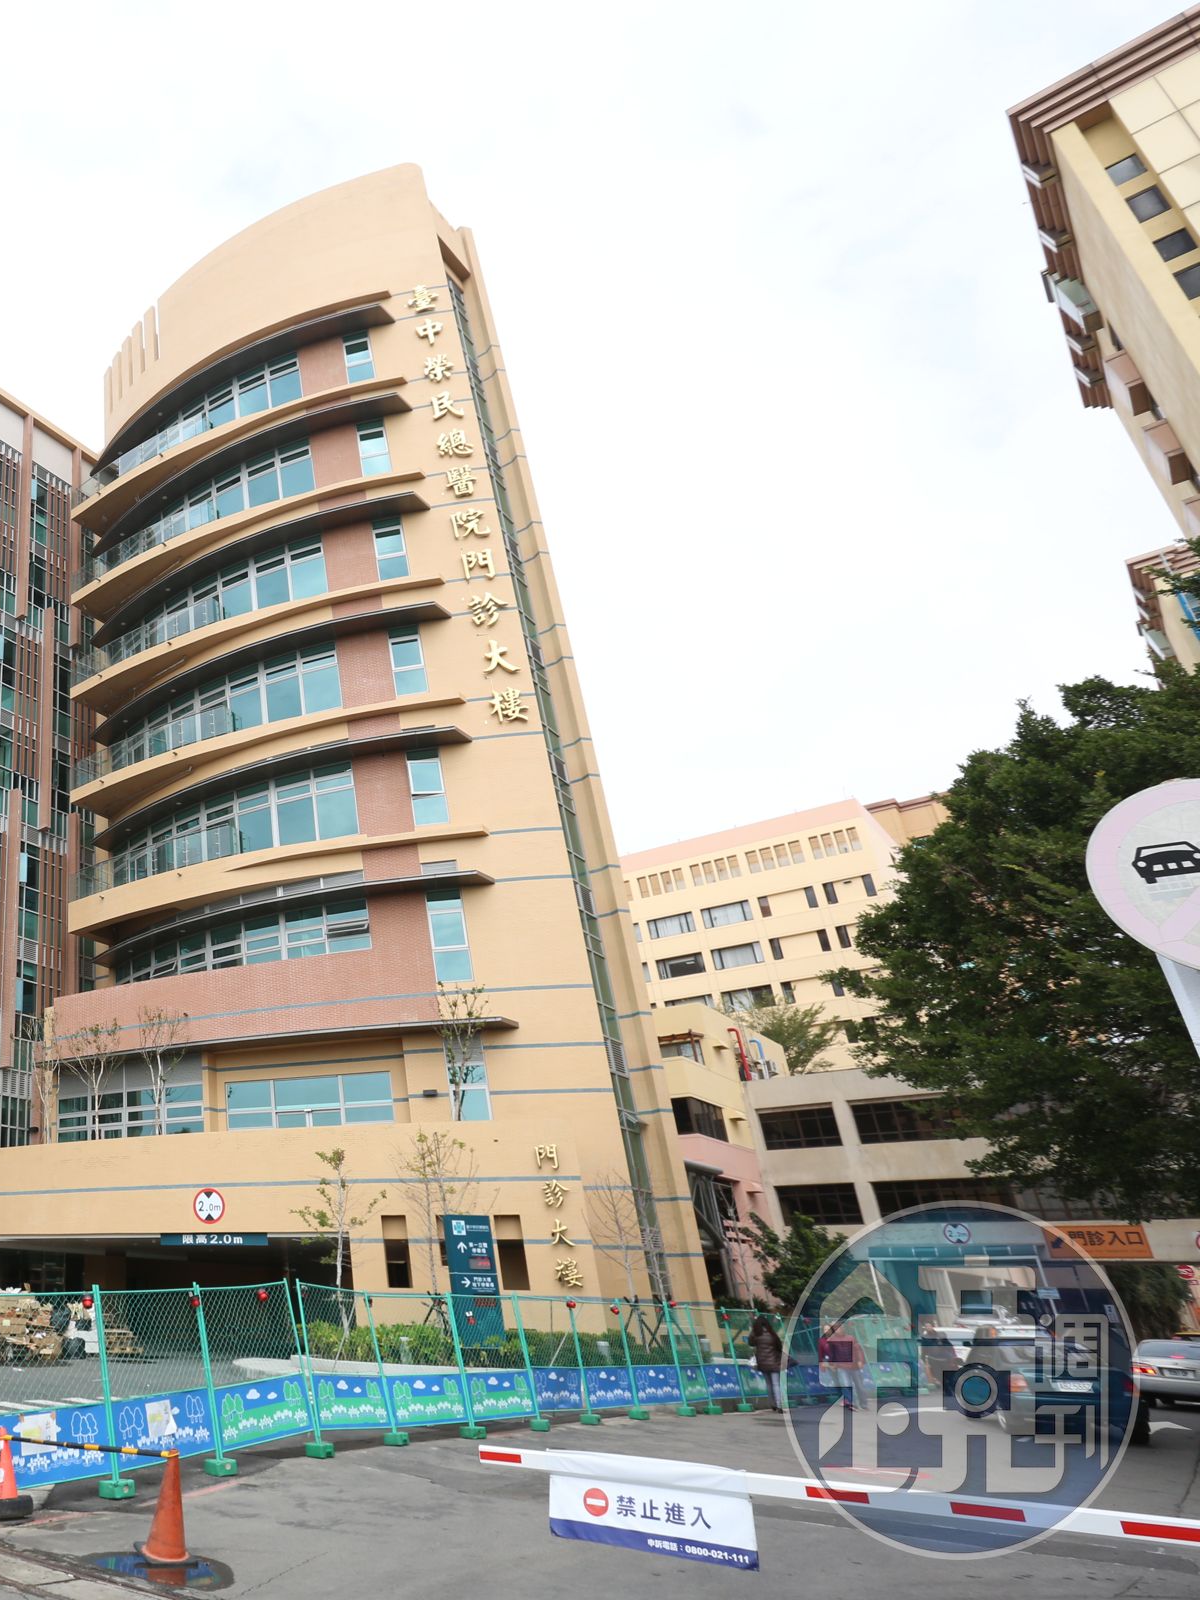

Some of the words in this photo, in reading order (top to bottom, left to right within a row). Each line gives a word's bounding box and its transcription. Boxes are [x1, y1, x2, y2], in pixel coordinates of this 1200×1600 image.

[407, 284, 529, 723] 臺中榮民總醫院門診大樓
[198, 1200, 221, 1212] 2.0m
[534, 1144, 584, 1287] 門診大樓
[182, 1234, 243, 1245] 限高2.0m
[1068, 1230, 1144, 1246] 門診入口
[616, 1495, 712, 1530] 禁止進入
